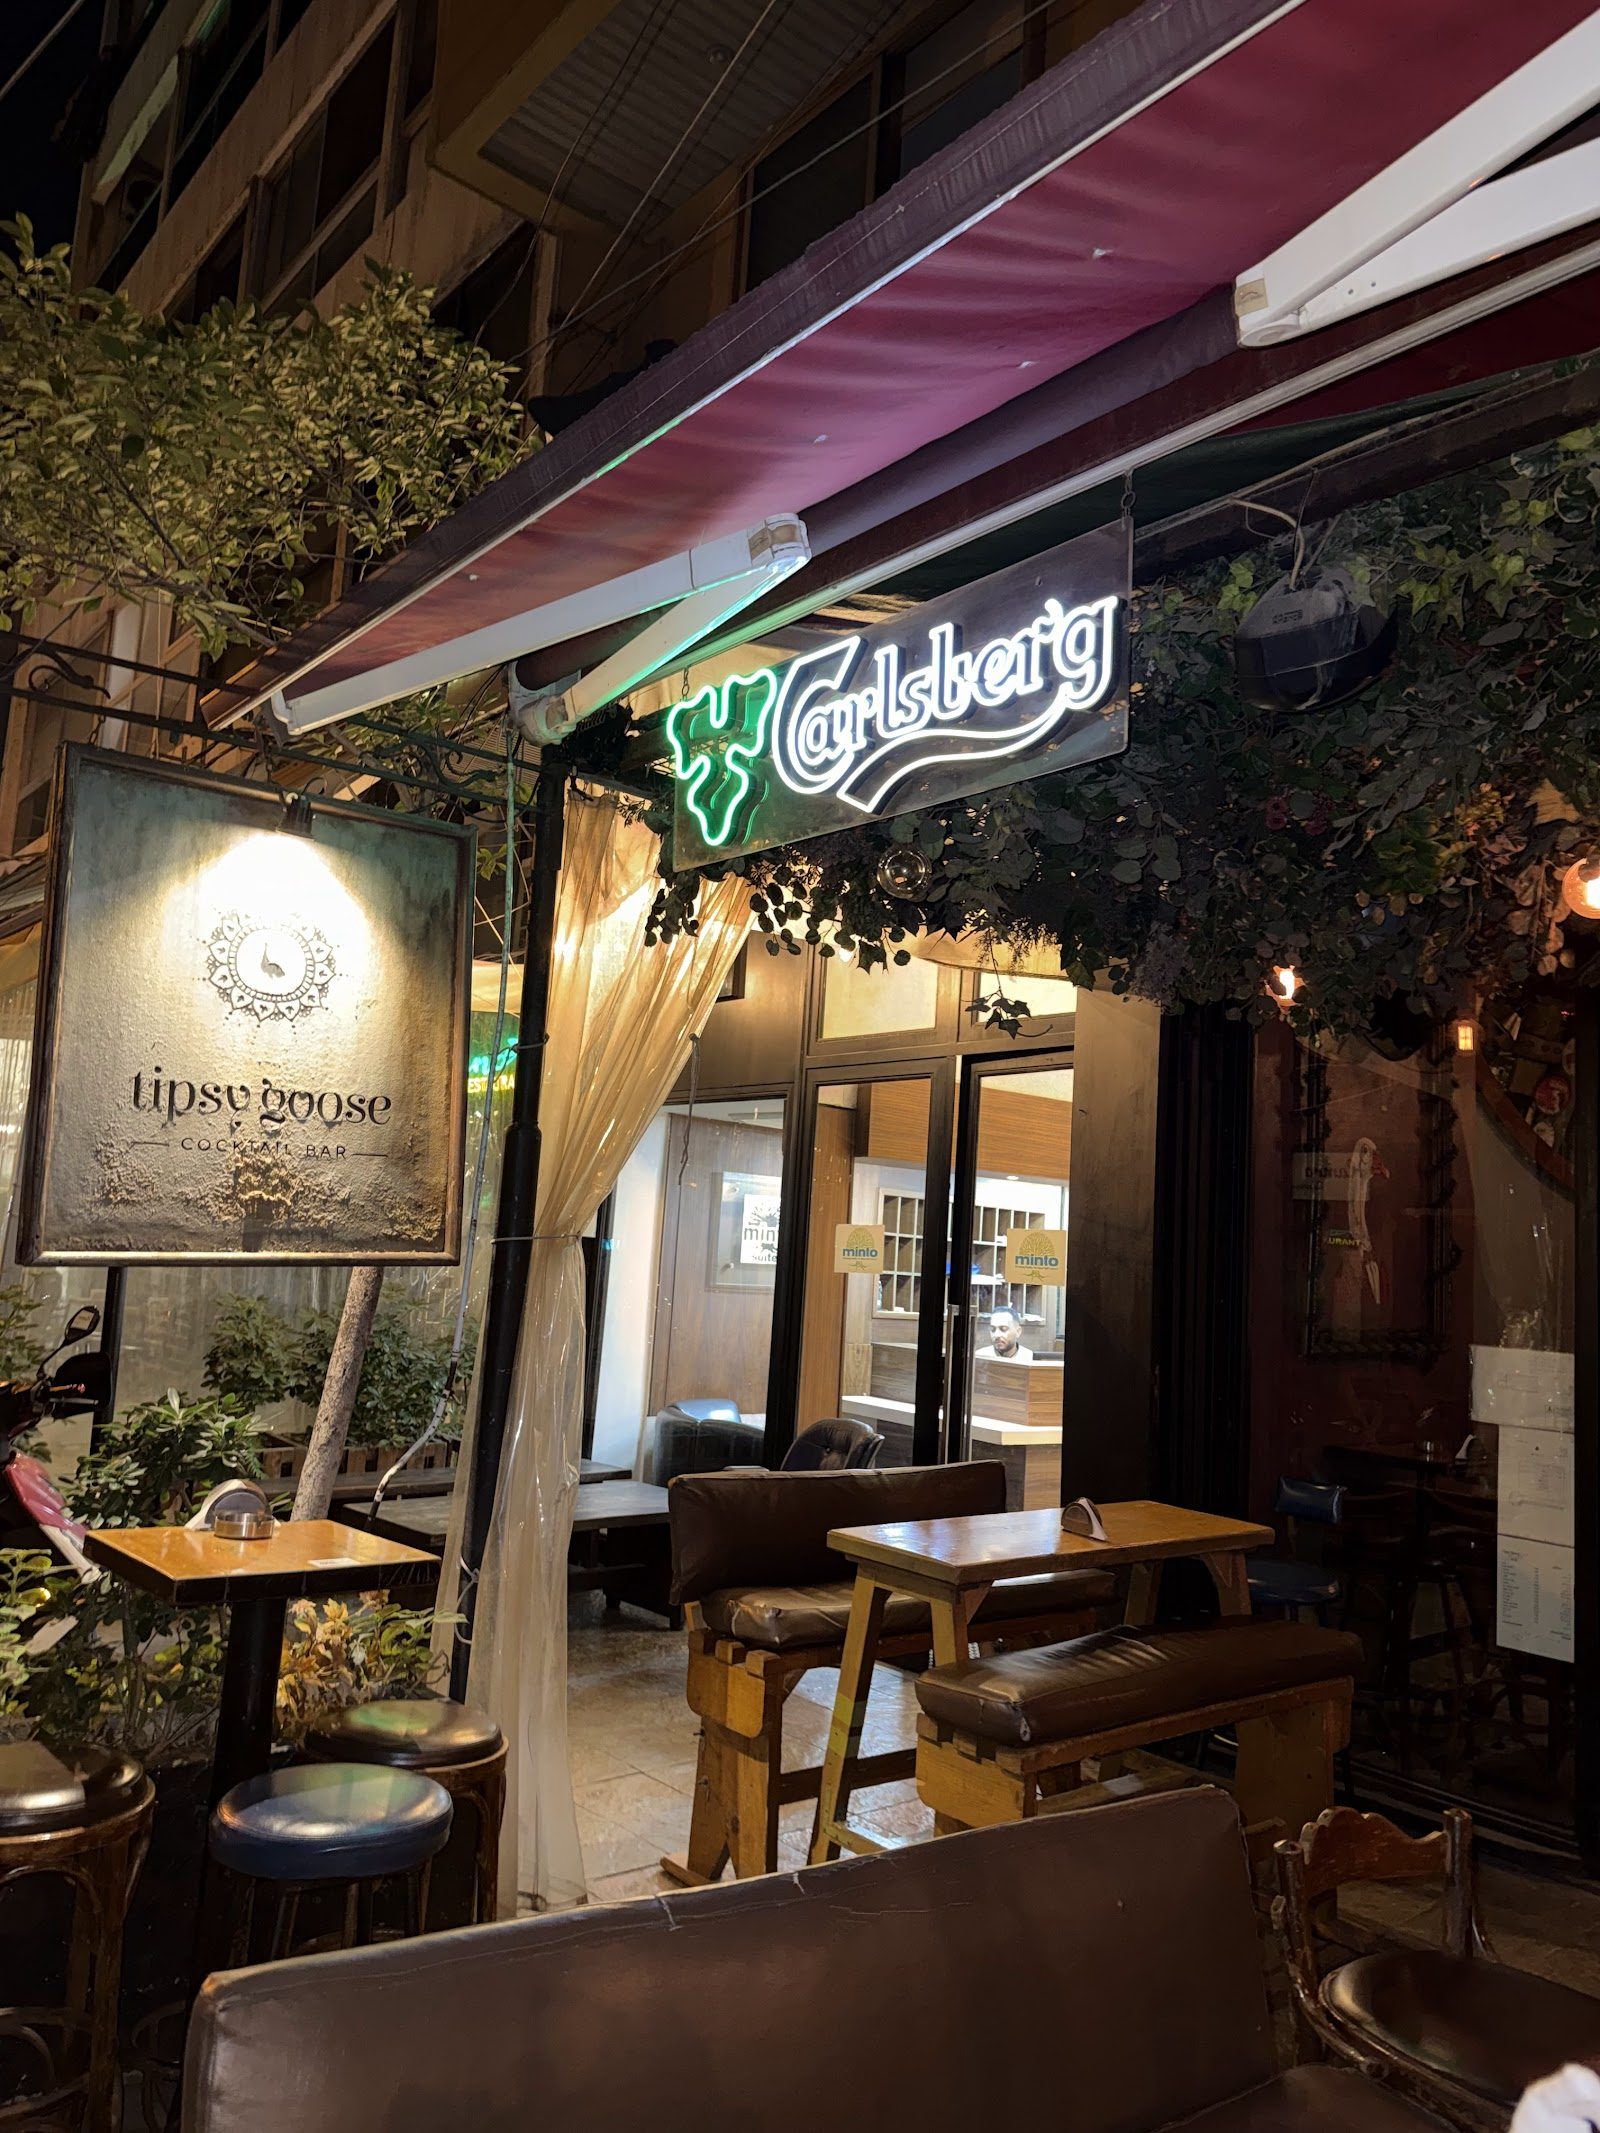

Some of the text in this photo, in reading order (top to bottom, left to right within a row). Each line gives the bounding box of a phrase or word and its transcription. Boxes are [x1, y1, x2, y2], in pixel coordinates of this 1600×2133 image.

[772, 595, 1120, 797] Carlsberg
[132, 1066, 391, 1133] tipsy goose
[181, 1137, 348, 1160] COCKTAIL BAR
[744, 1228, 779, 1241] min
[842, 1247, 878, 1258] minto
[1015, 1254, 1059, 1267] minto
